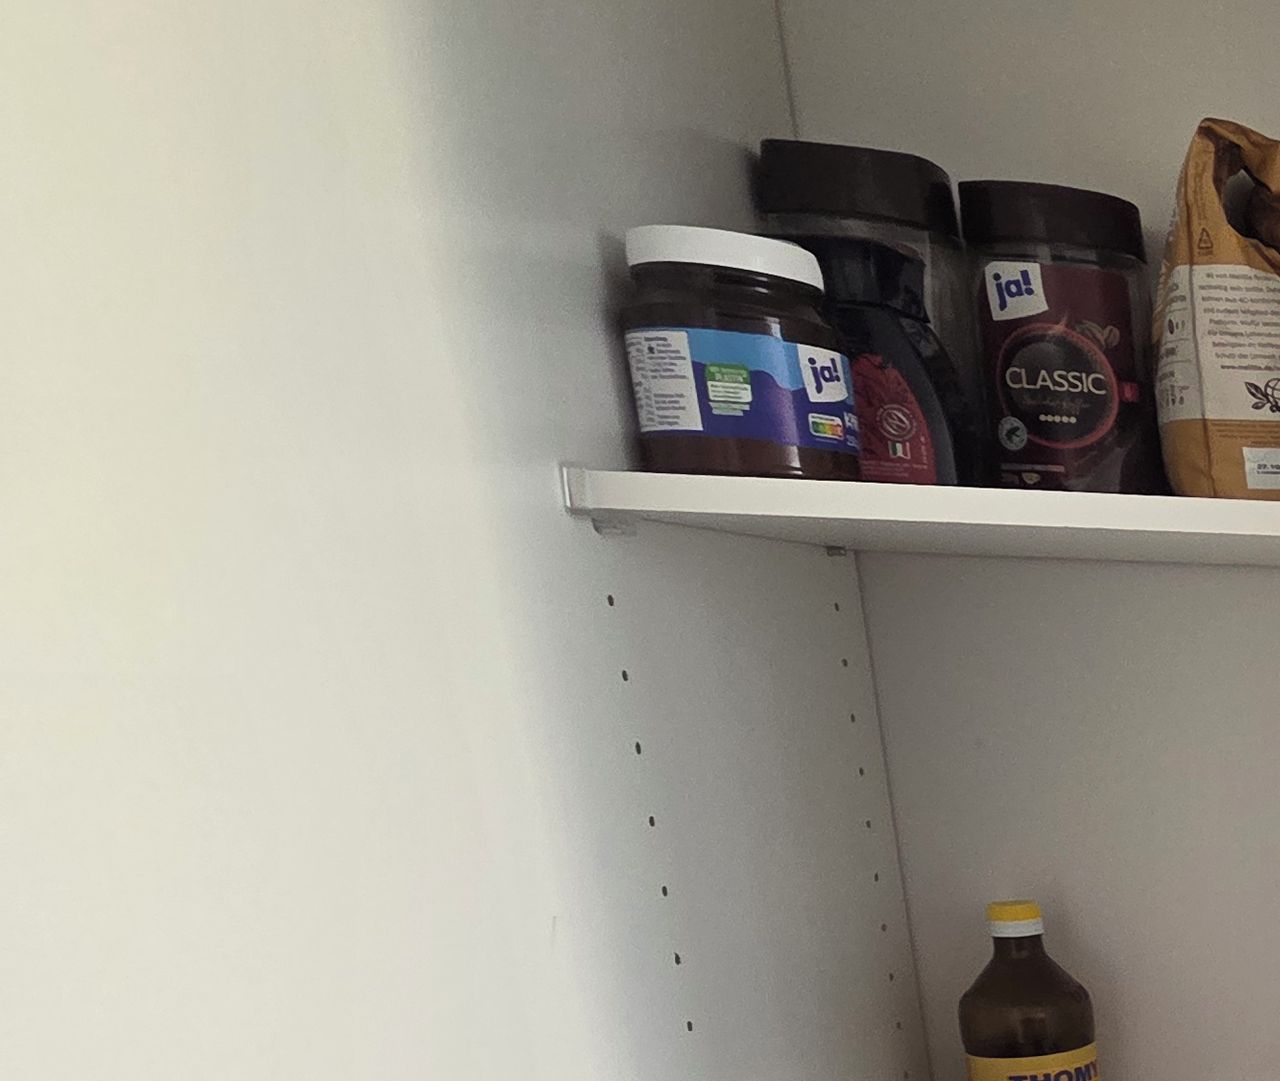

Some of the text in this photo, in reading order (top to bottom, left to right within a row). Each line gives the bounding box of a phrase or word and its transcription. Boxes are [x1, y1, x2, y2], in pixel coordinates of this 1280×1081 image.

[992, 269, 1035, 311] ja!
[808, 356, 841, 394] ja!
[1005, 366, 1107, 395] CLASSIC
